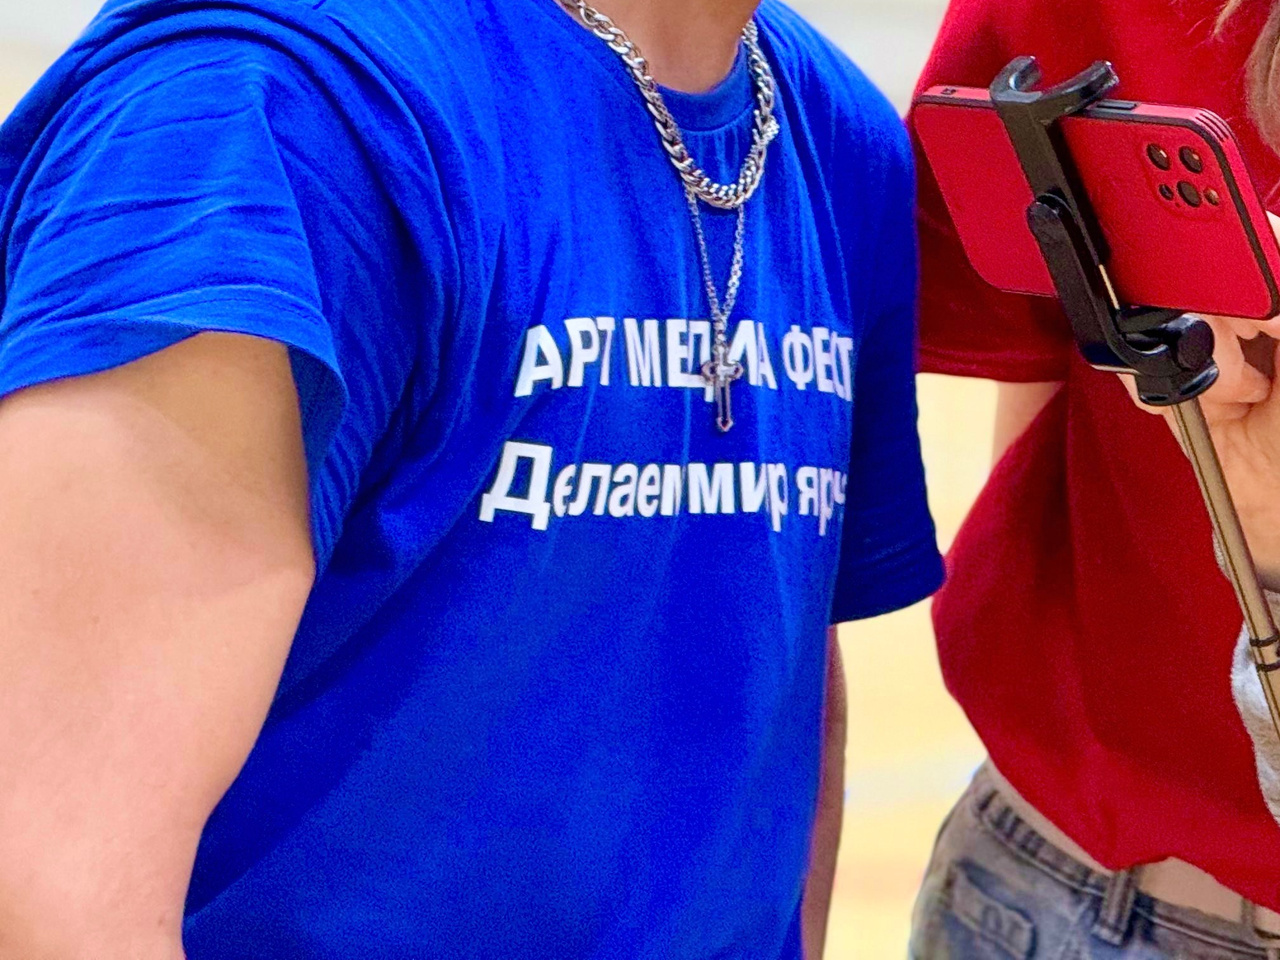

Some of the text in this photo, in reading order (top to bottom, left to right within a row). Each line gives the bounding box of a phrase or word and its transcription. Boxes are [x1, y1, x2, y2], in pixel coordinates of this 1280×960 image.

[514, 317, 615, 397] АРТ
[479, 441, 848, 537] Делаем мир ярч
